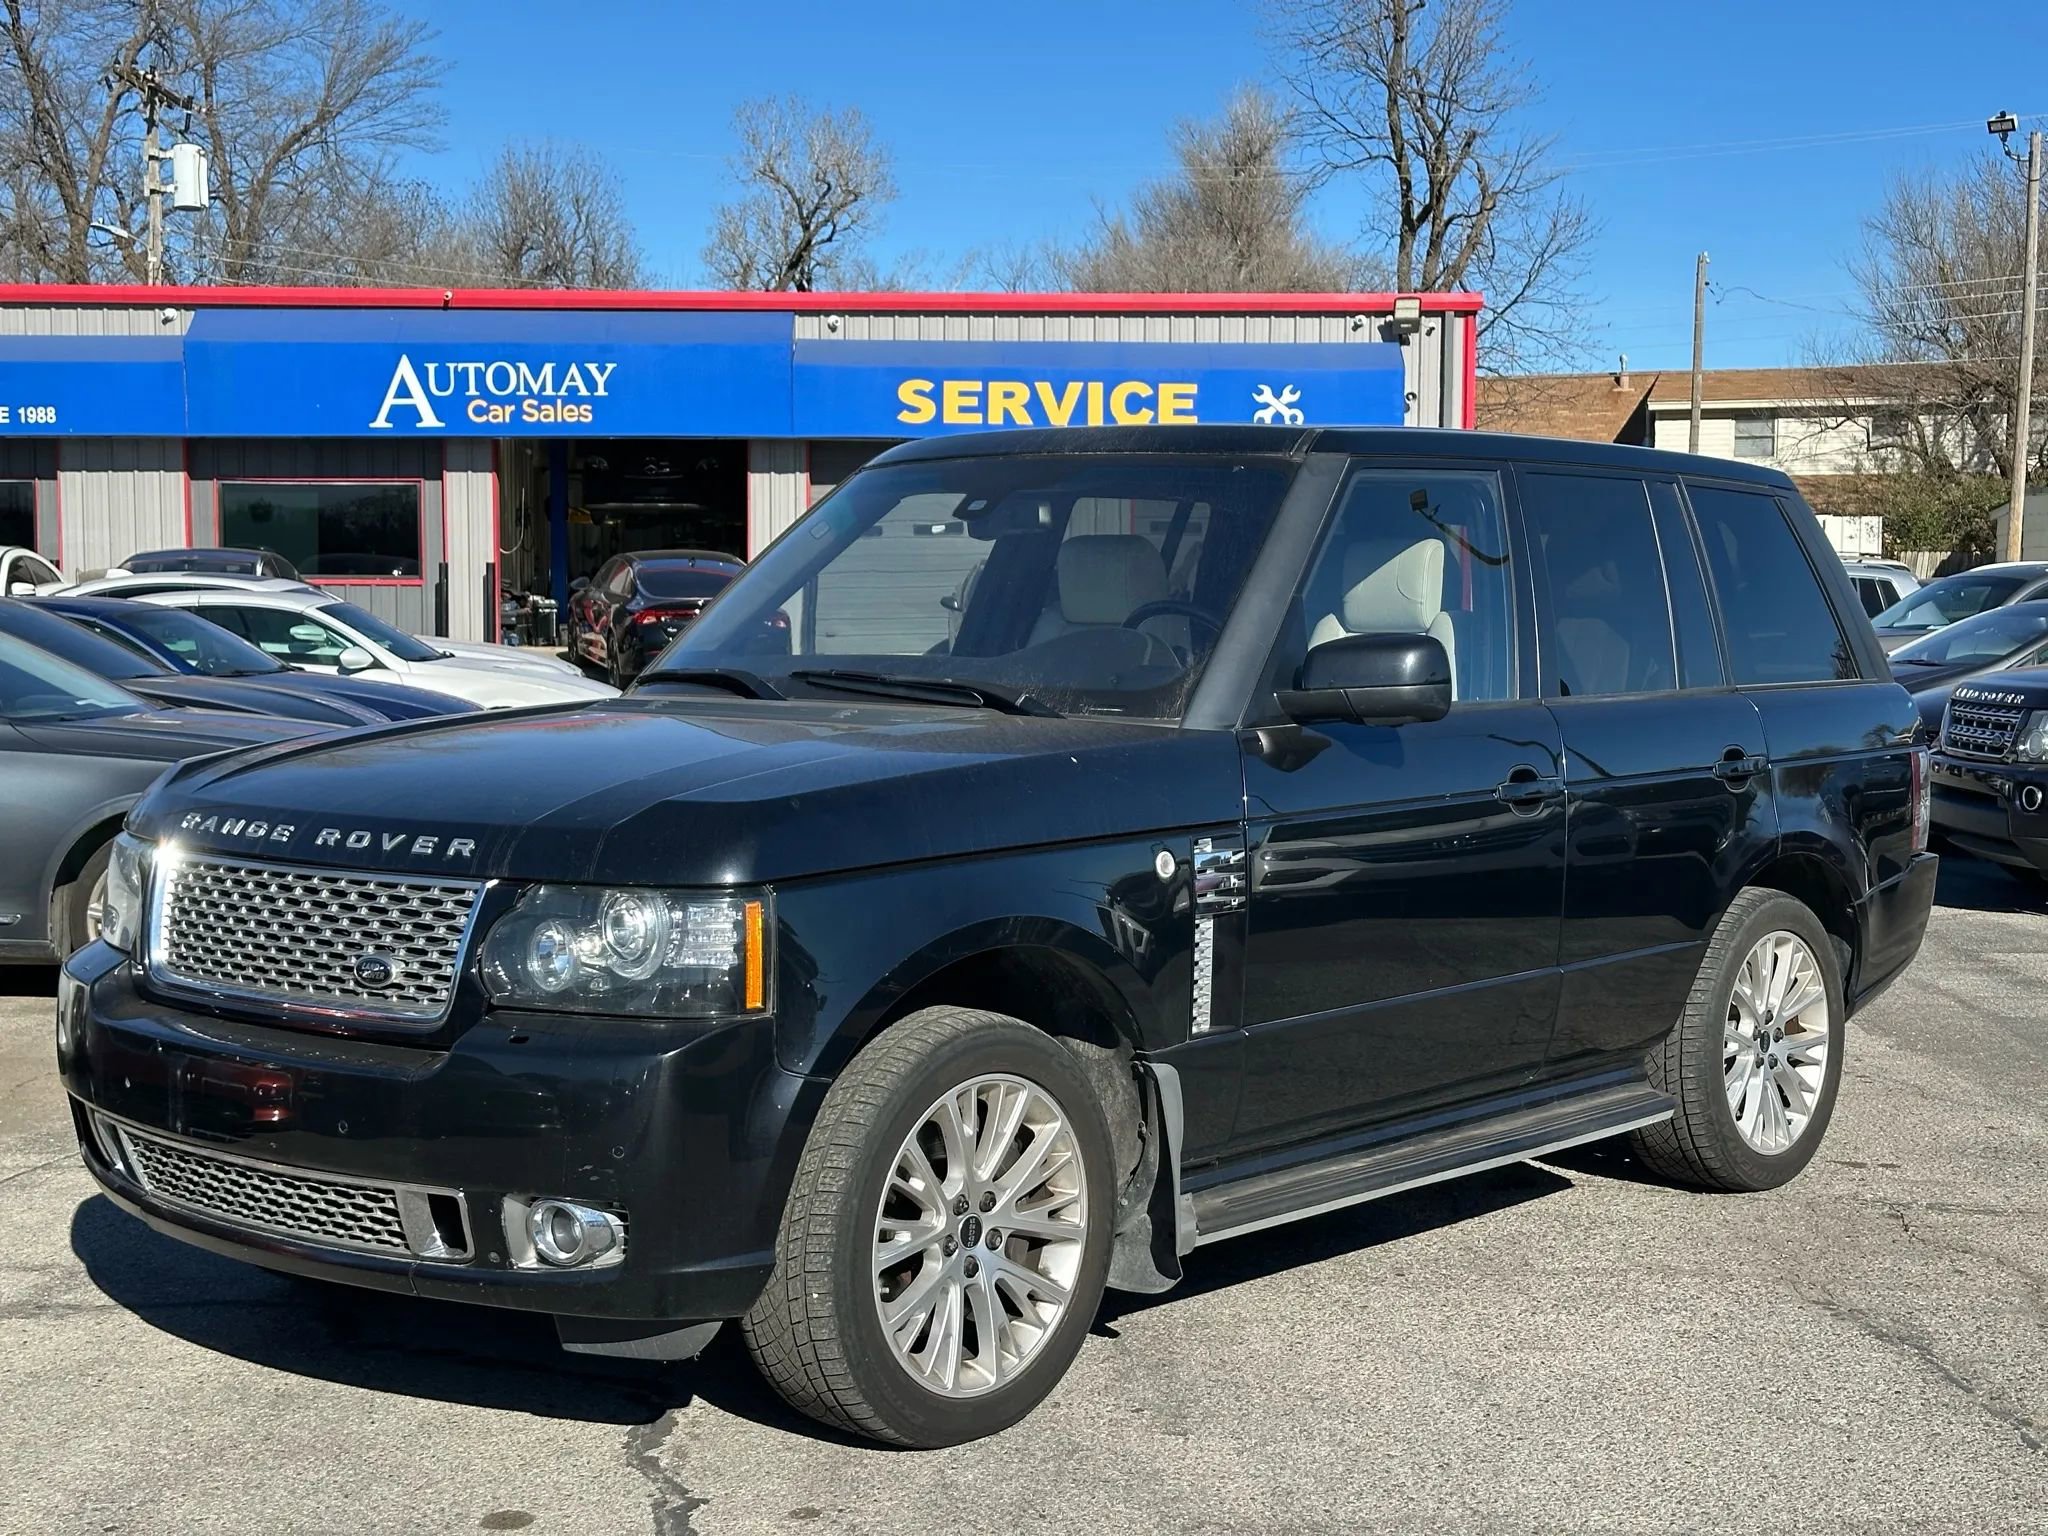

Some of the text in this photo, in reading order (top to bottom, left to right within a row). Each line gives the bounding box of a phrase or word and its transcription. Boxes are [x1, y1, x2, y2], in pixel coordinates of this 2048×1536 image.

[368, 353, 618, 428] AUTOMAY
[467, 398, 594, 423] Car Sales
[896, 379, 1199, 425] SERVICE
[17, 406, 57, 424] 1988
[180, 811, 476, 858] RANGE ROVER
